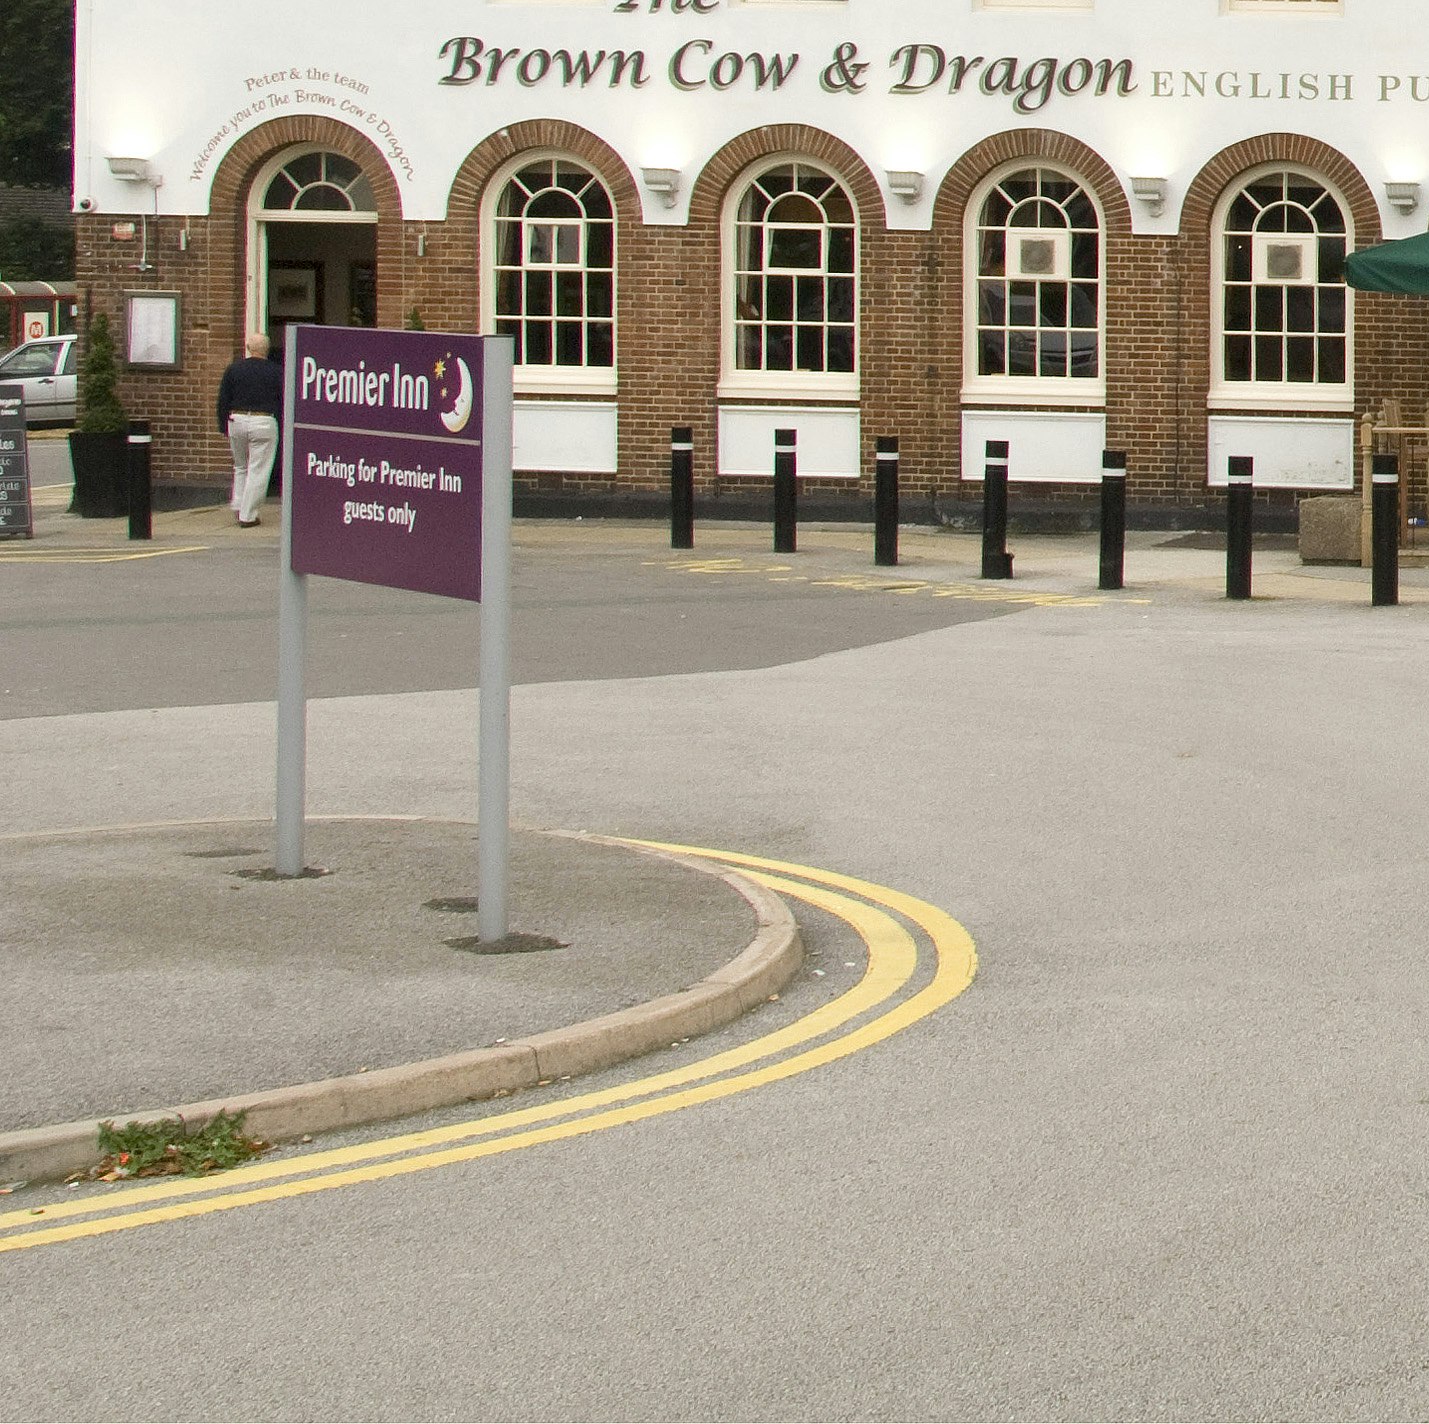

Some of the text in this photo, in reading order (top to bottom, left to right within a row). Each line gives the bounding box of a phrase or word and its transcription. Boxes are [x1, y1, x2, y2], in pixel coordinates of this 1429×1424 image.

[243, 68, 370, 95] Peter & the team
[438, 36, 1139, 115] Brown Cow & Dragon
[1150, 70, 1355, 101] ENGLISH
[189, 124, 231, 182] Welcome
[229, 106, 252, 132] you
[252, 99, 267, 113] to
[267, 92, 290, 108] The
[294, 89, 336, 108] Brown
[339, 99, 366, 119] Cow
[376, 119, 415, 182] Dragon
[301, 356, 429, 411] Premier Inn
[307, 452, 462, 493] Parking for Premier Inn
[343, 500, 417, 533] guests only
